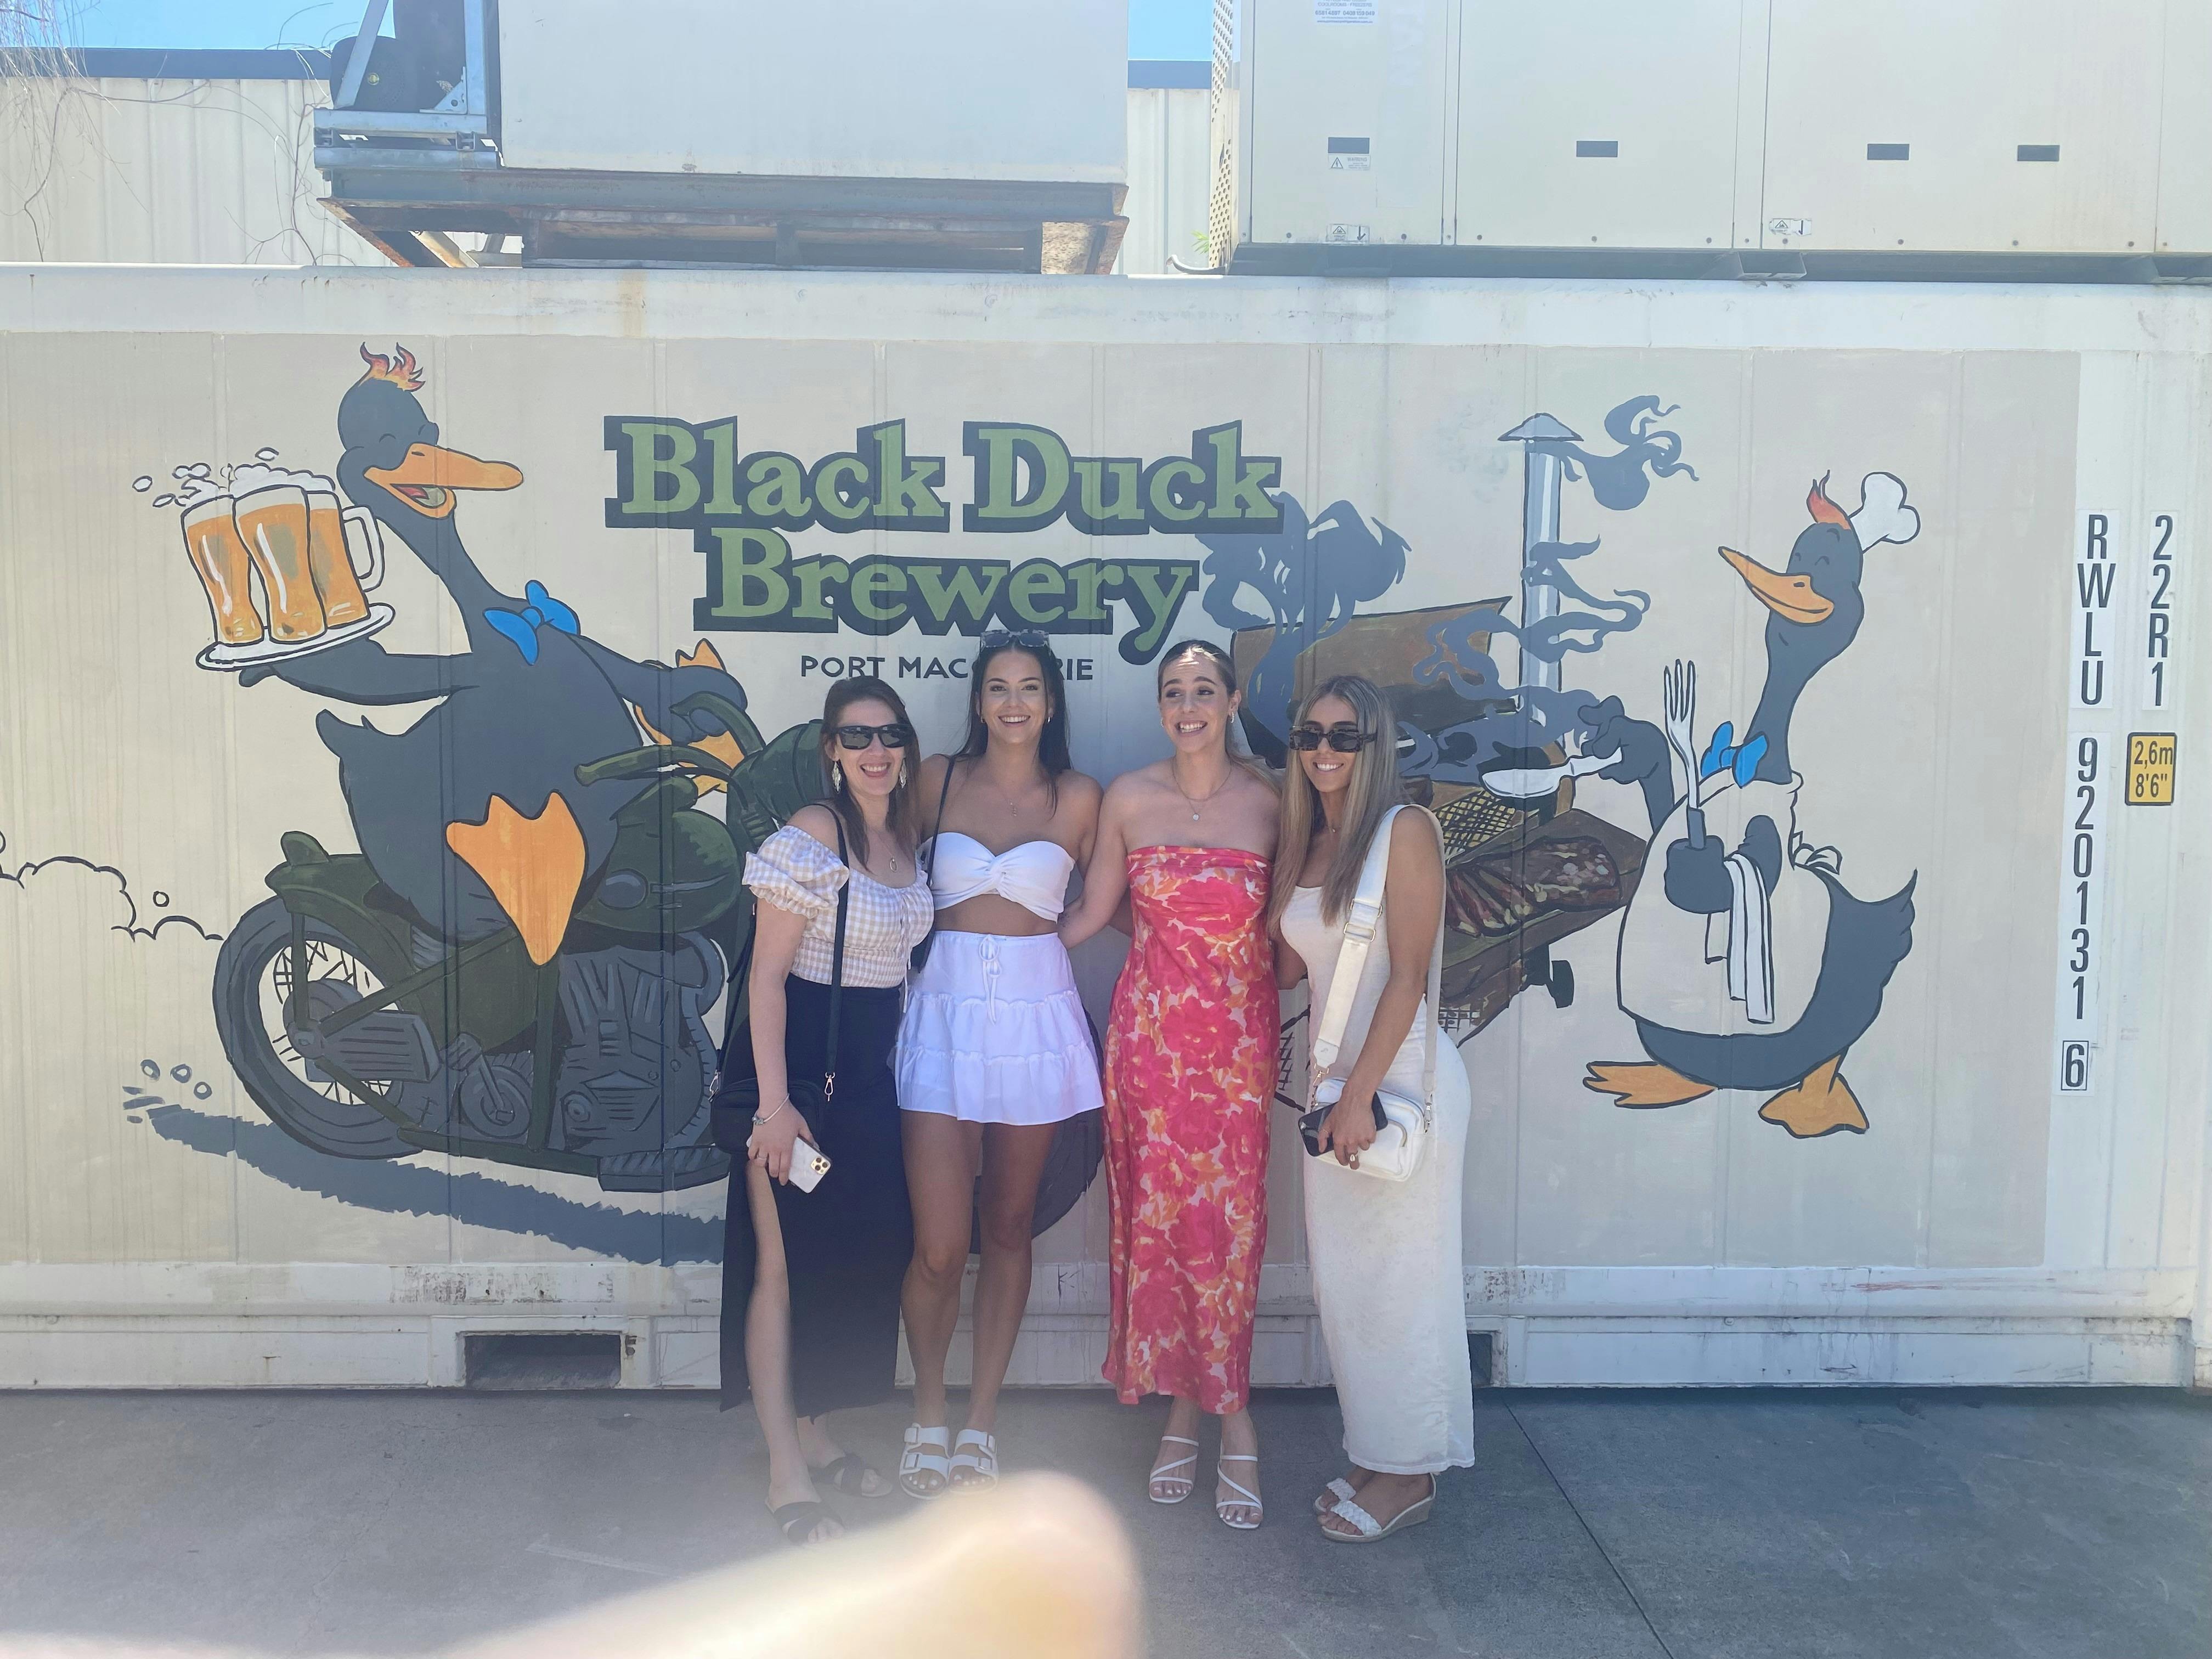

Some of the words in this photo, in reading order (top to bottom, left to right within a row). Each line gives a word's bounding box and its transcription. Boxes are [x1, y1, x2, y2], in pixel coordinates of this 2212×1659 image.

[605, 416, 949, 533] Black
[963, 420, 1283, 535] Duck
[694, 528, 1199, 664] Brewery
[2077, 514, 2116, 706] RWLU
[2148, 515, 2173, 707] 22R1
[802, 656, 885, 679] PORT
[2134, 740, 2174, 769] 2,6m
[2135, 773, 2168, 798] 8'6"
[2070, 737, 2098, 1021] 920131
[2066, 1044, 2085, 1087] 6
